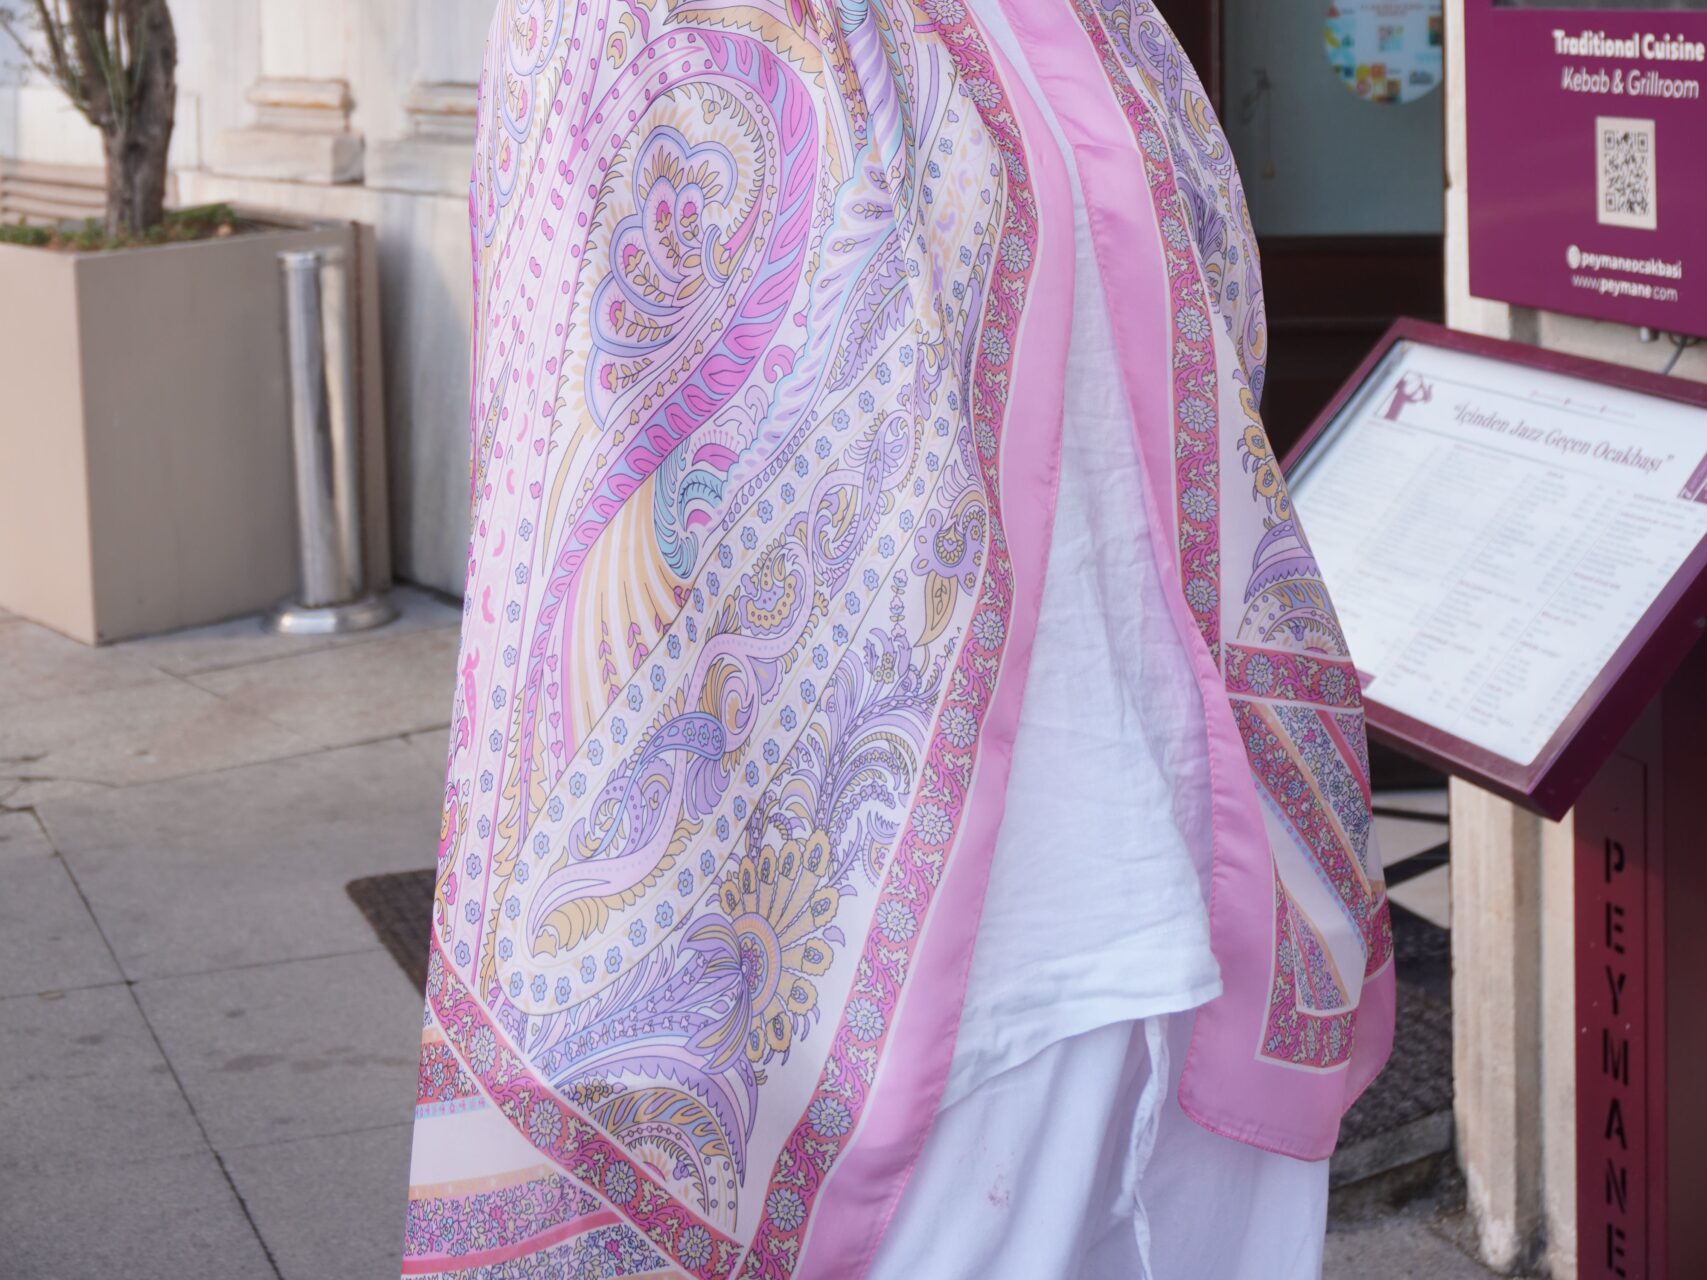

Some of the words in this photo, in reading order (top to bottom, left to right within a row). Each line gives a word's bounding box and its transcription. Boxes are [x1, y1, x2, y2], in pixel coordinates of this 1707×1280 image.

[1552, 29, 1640, 59] Traditional
[1642, 33, 1705, 62] Cuisine
[1561, 66, 1610, 94] Kebab
[1611, 68, 1624, 95] &
[1627, 69, 1700, 99] Grillroom
[1571, 274, 1678, 302] www.peymane.com
[1509, 419, 1545, 442] Jazz
[1544, 428, 1592, 456] Geçen
[1603, 836, 1629, 1278] PEYMANE
